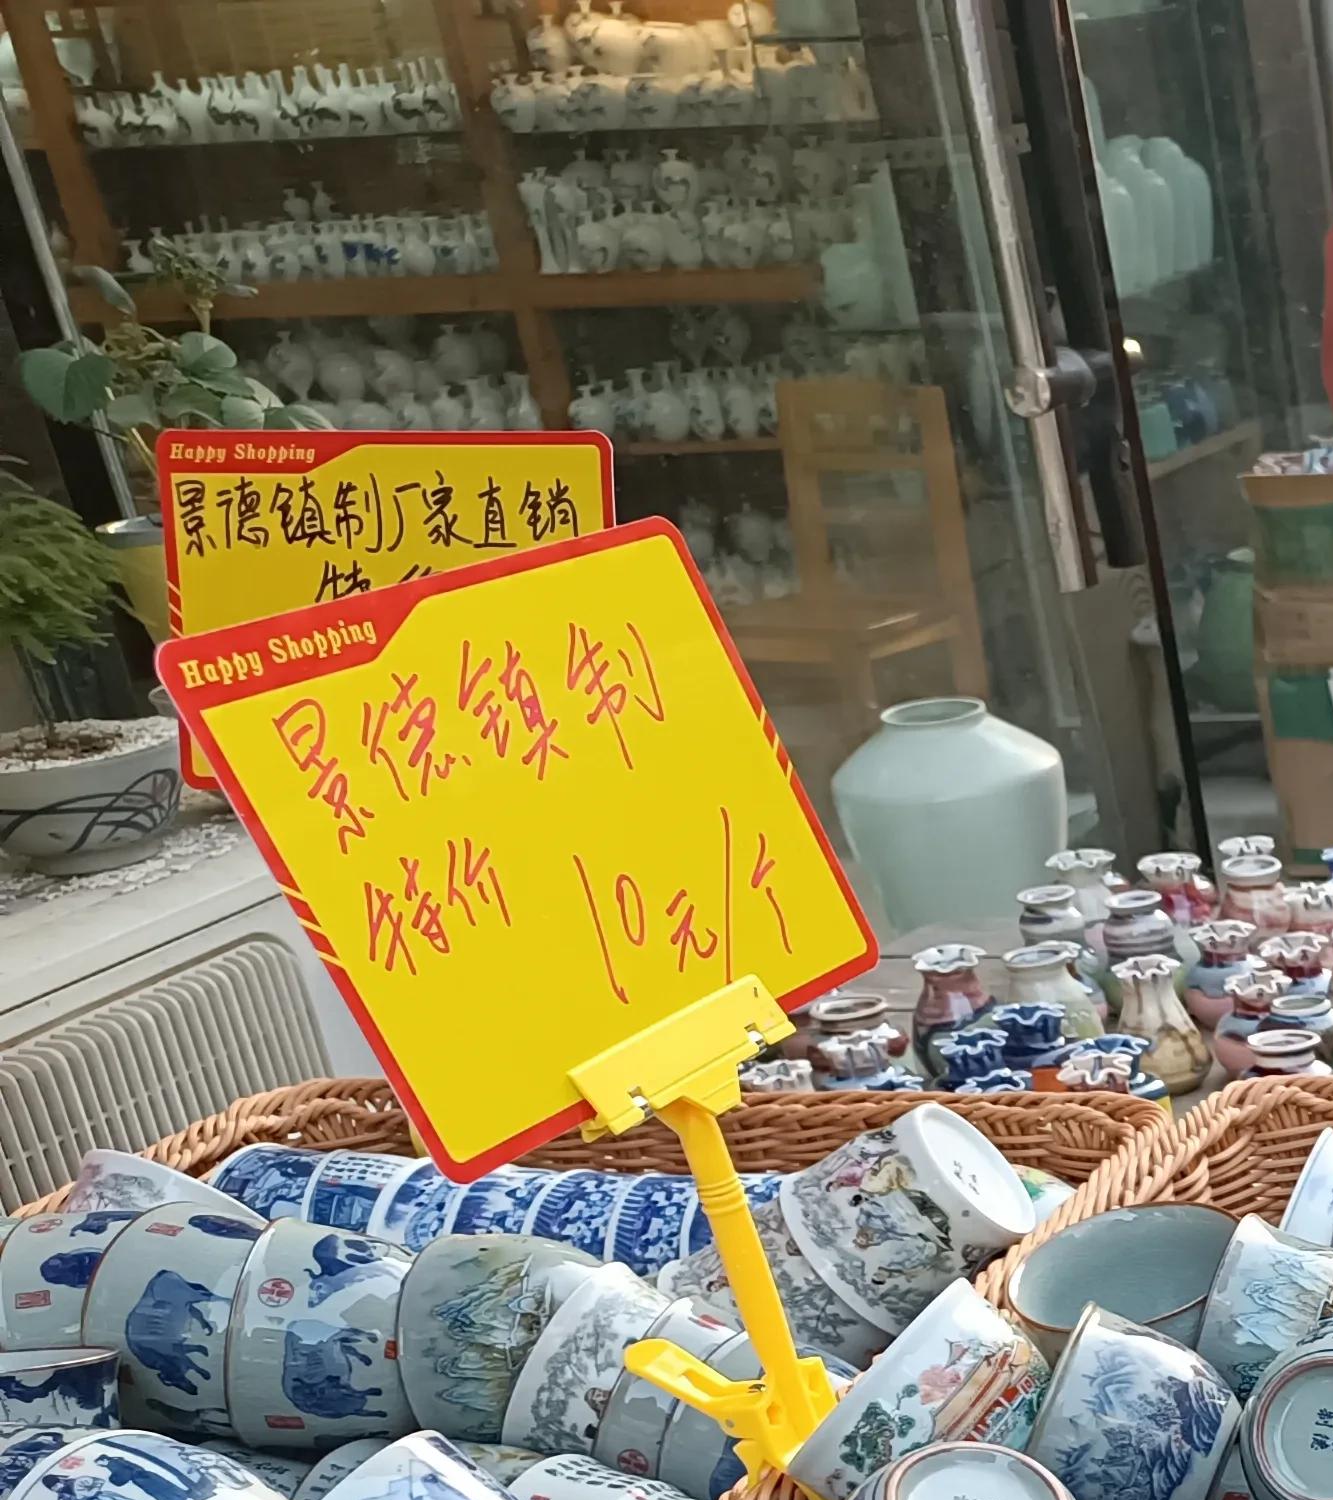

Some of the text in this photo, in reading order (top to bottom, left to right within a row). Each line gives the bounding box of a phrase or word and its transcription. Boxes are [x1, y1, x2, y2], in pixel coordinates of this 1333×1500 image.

[169, 443, 316, 464] Happy Shopping
[178, 619, 378, 689] Happy Shopping
[363, 837, 510, 976] 特价
